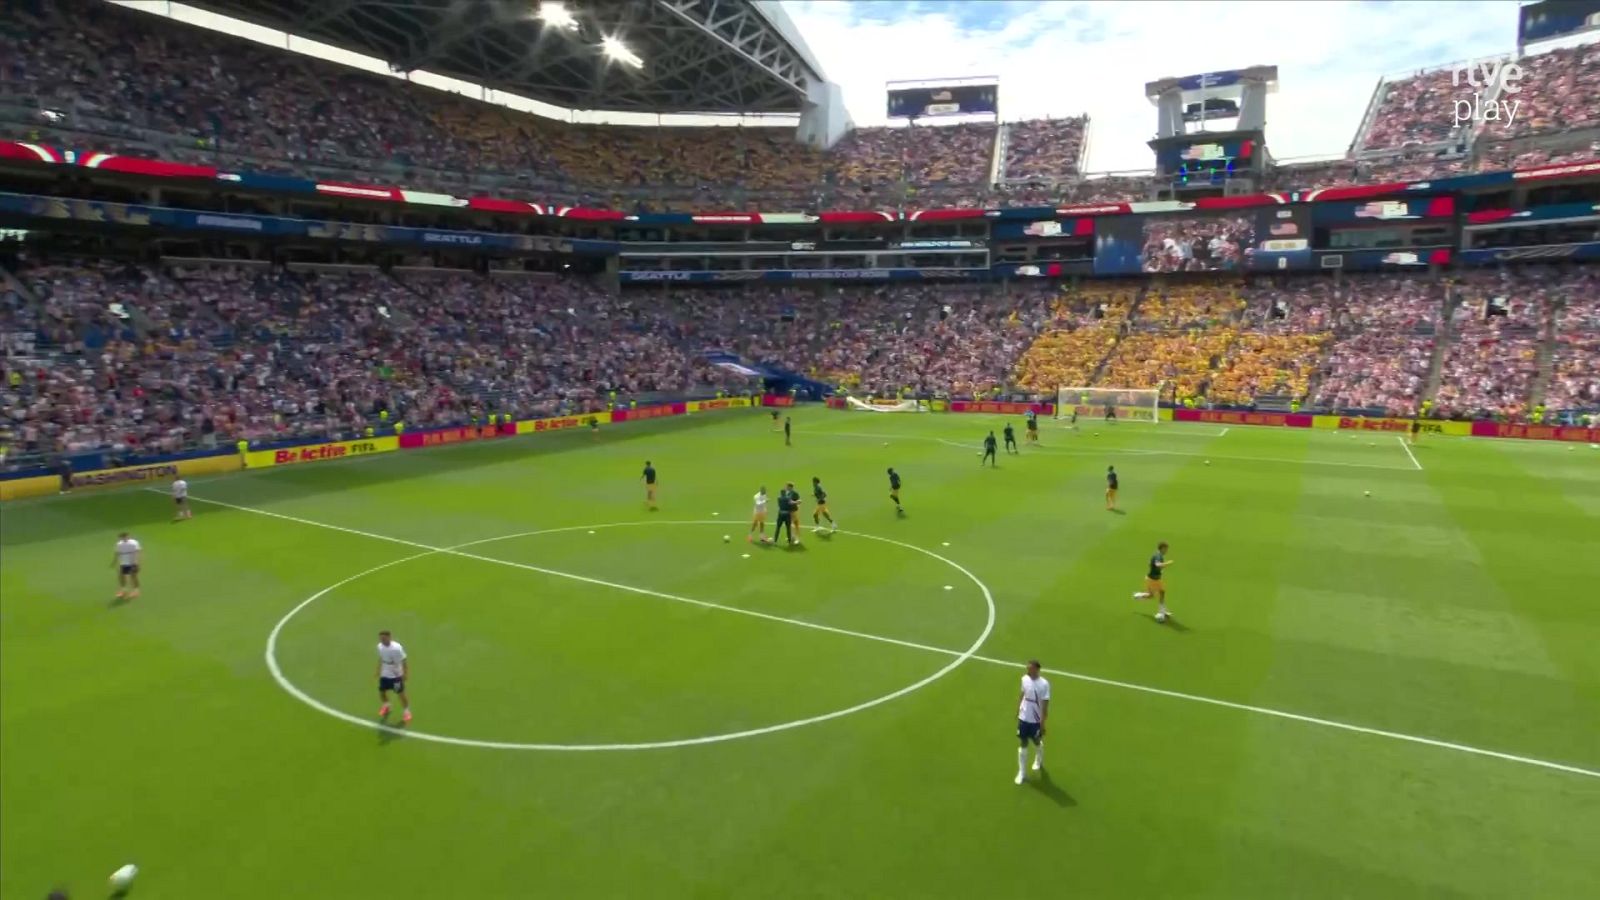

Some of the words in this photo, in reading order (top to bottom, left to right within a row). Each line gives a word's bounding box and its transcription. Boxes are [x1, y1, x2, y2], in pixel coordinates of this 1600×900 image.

[275, 449, 297, 464] Be
[301, 445, 346, 462] Active
[352, 443, 375, 453] FIFA
